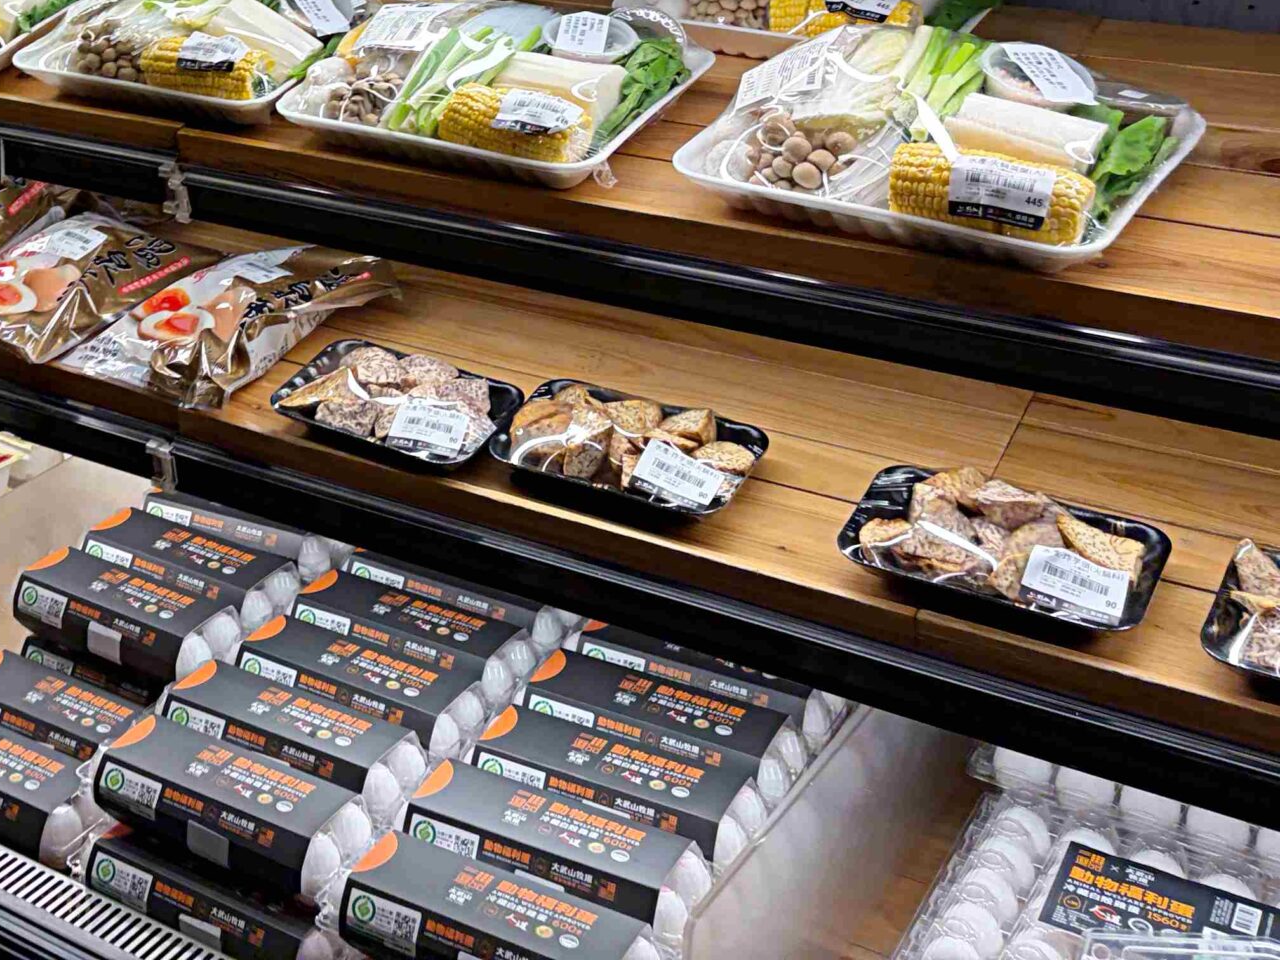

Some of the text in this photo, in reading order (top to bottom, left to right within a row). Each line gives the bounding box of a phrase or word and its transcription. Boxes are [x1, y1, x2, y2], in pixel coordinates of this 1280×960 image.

[1024, 196, 1043, 208] 445
[1104, 599, 1117, 609] 90
[1066, 878, 1101, 894] ANIMAL
[1145, 903, 1193, 924] APPROVED
[1069, 865, 1196, 919] 動物福利蛋
